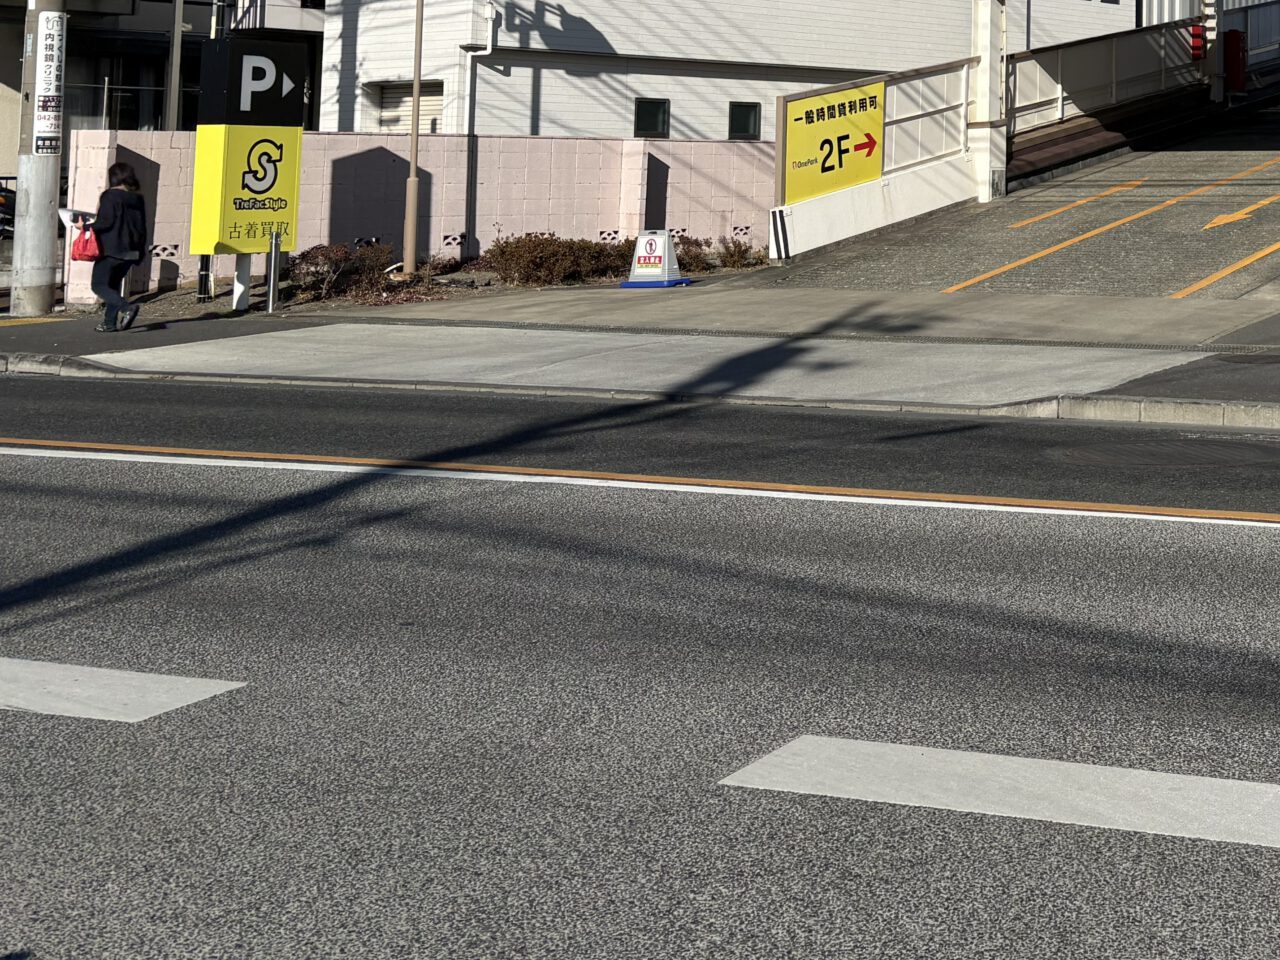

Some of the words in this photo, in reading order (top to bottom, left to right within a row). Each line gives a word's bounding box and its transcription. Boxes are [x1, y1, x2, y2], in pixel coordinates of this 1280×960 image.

[43, 33, 55, 93] 内視鏡クリニック
[239, 54, 277, 112] P
[794, 95, 877, 125] 一般時間貸利用可
[820, 133, 850, 174] 2F
[233, 197, 288, 212] TreFacStyle
[228, 221, 290, 240] 古着買取
